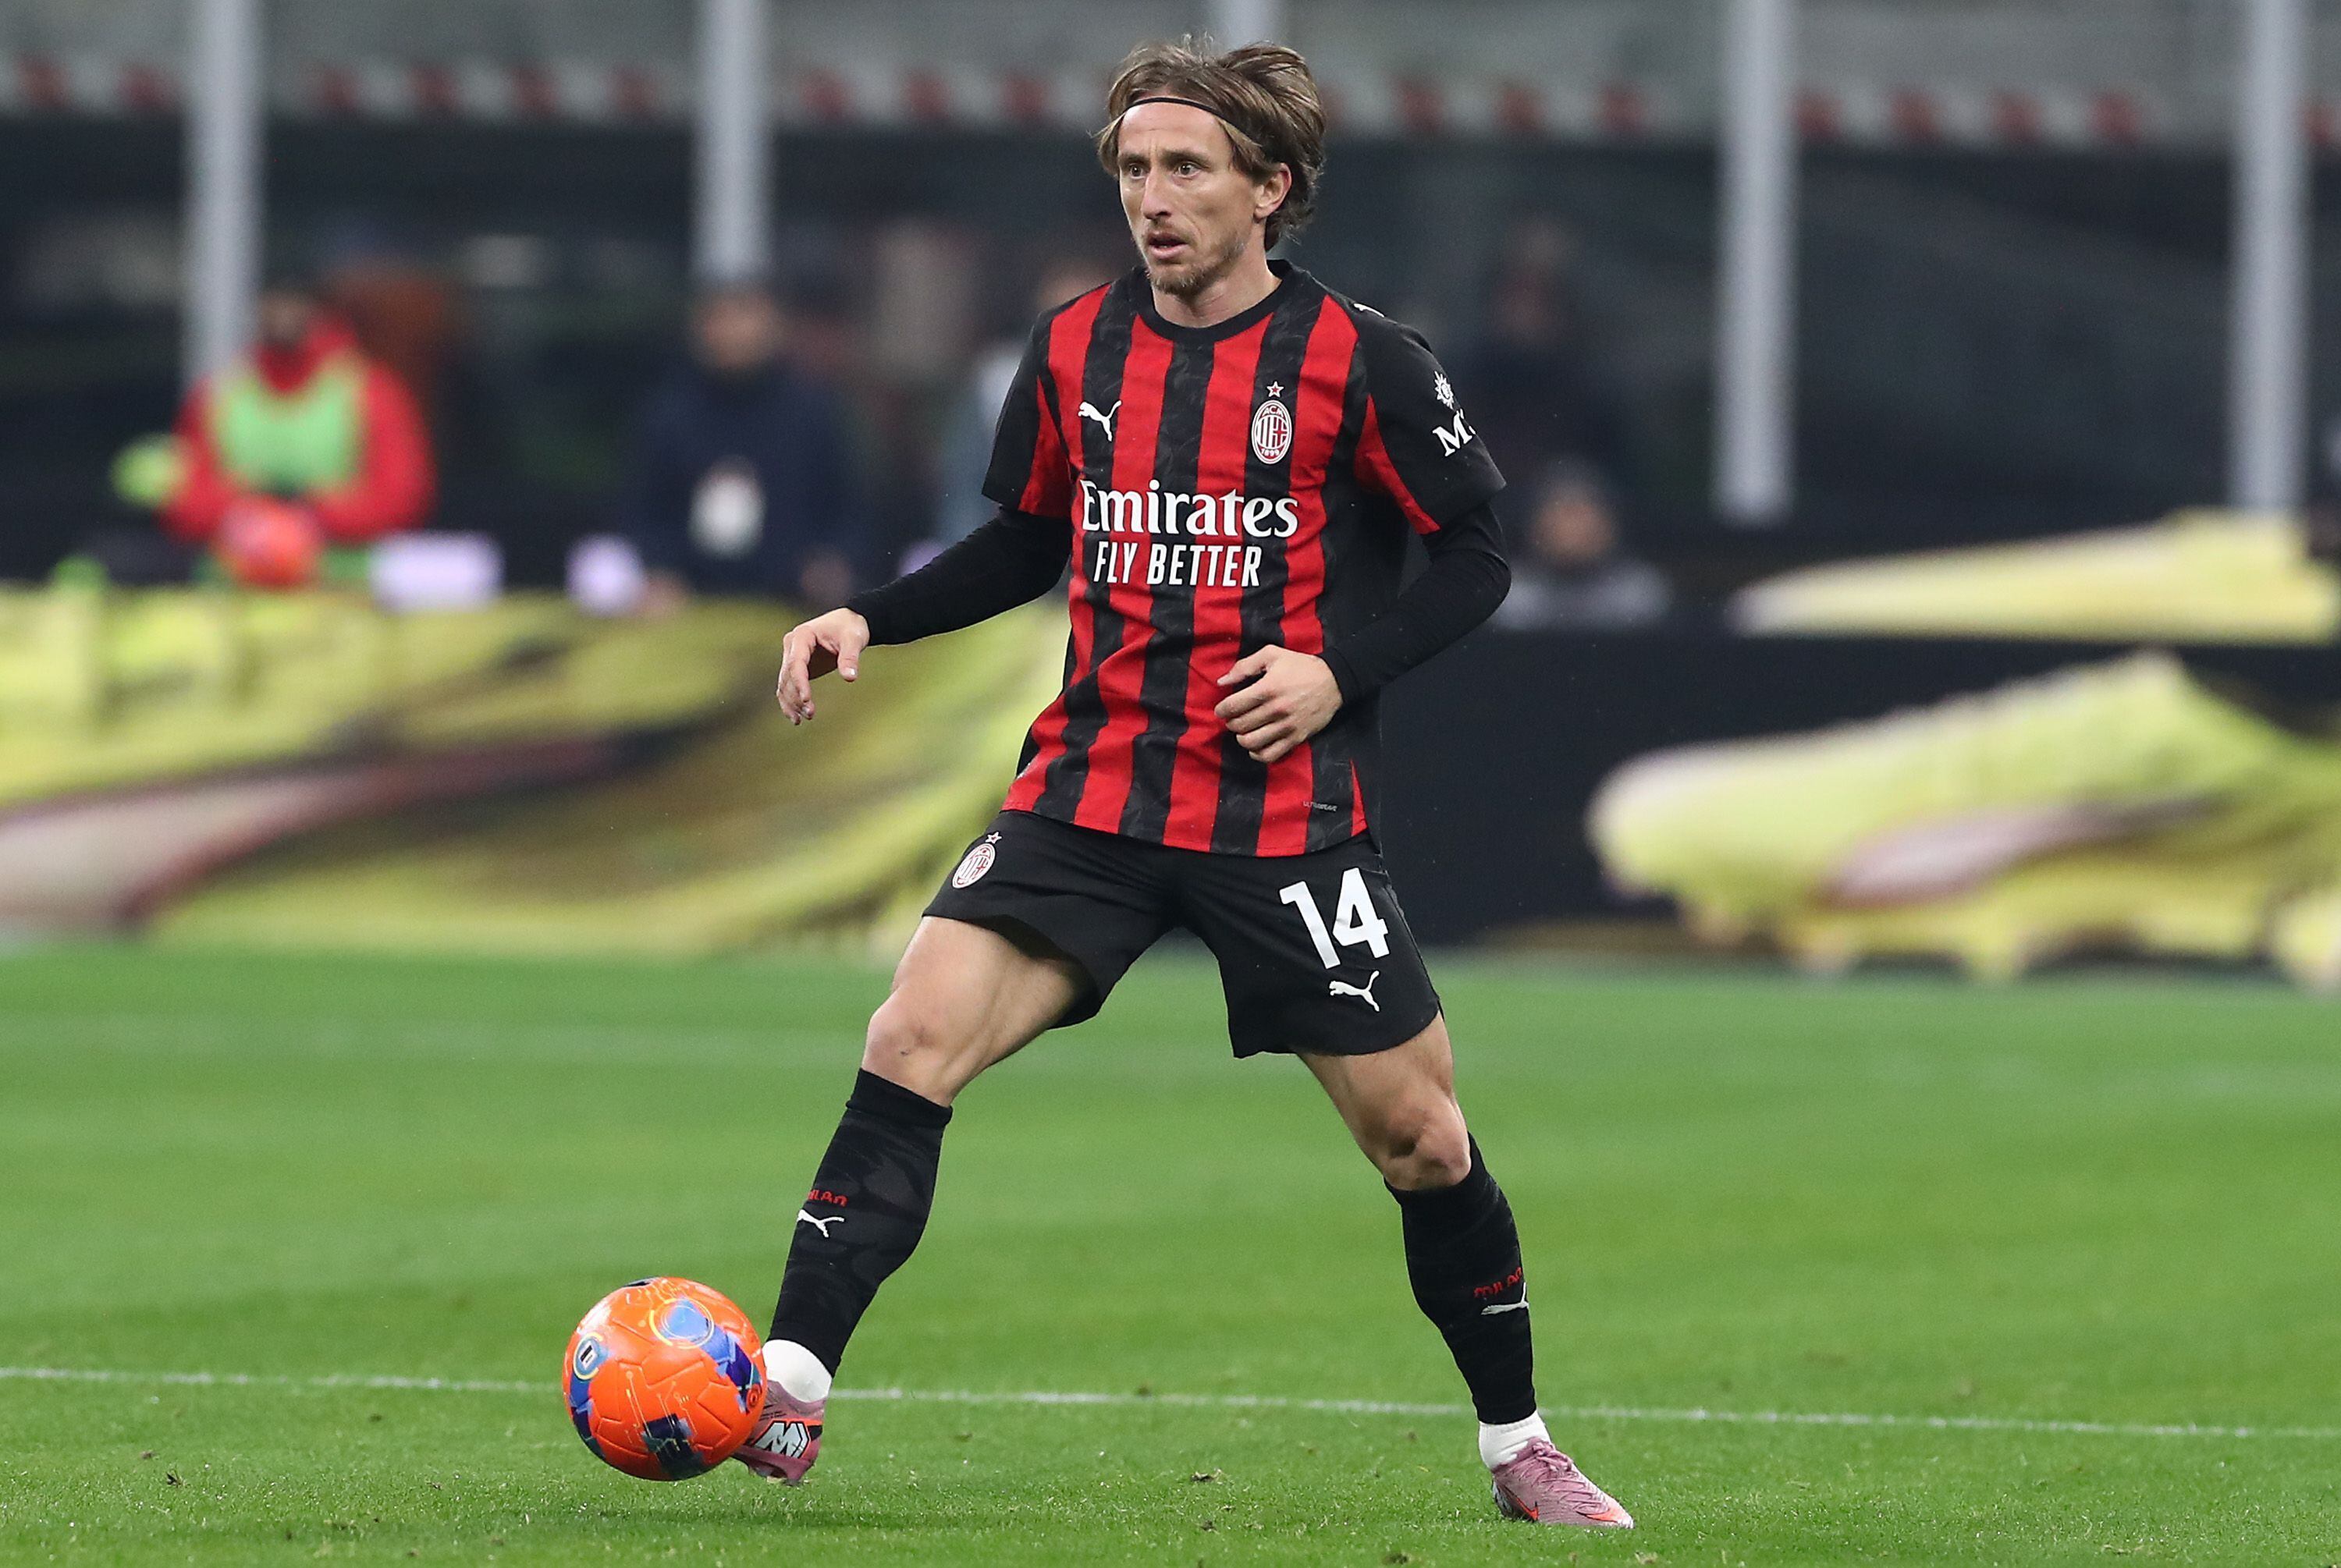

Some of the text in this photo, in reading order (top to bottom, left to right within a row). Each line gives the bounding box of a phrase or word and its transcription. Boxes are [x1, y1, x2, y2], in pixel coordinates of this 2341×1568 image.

[1261, 406, 1284, 417] ACM
[1079, 479, 1298, 537] Emirates
[1093, 541, 1263, 587] FLY BETTER
[1279, 867, 1390, 969] 14
